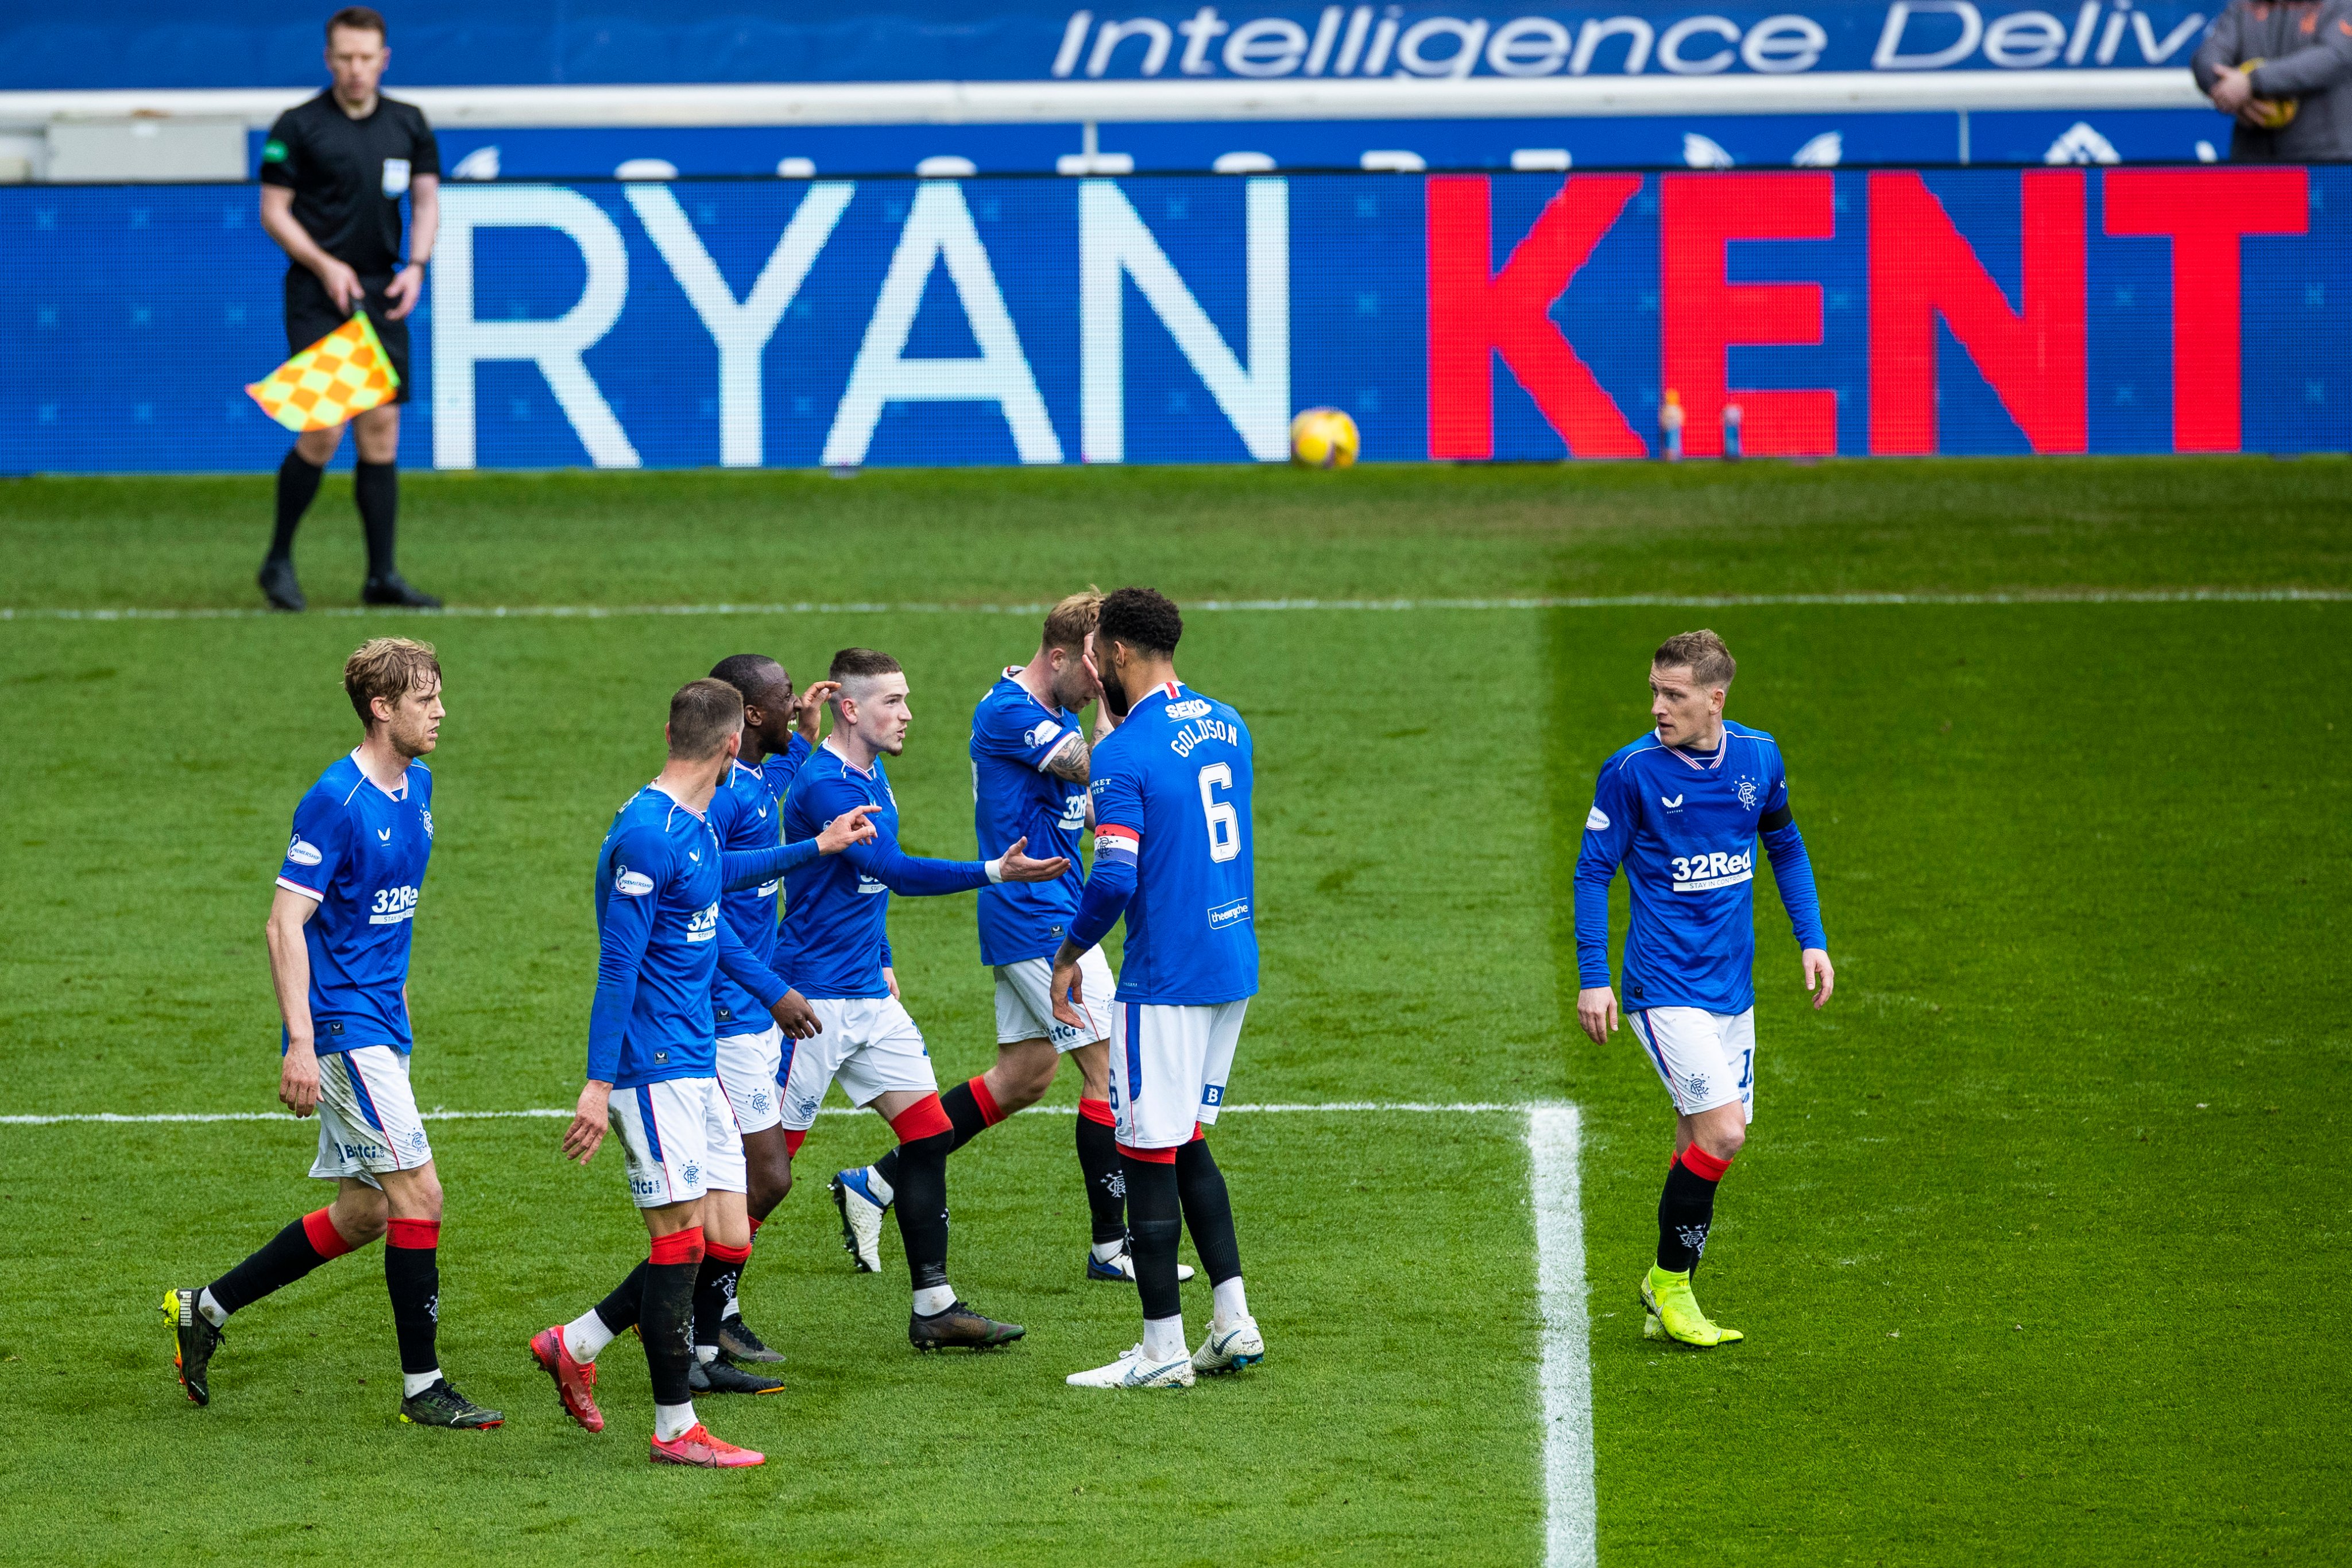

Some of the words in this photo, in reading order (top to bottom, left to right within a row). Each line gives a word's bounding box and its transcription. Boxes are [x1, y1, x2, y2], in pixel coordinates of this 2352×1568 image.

[1051, 5, 1828, 80] Intelligence
[1871, 0, 2207, 68] Deliv
[432, 177, 1290, 470] RYAN
[1426, 167, 2309, 460] KENT
[1165, 699, 1207, 719] SEKO
[1171, 719, 1237, 758] GOLDSON
[1198, 762, 1241, 863] 6
[1672, 846, 1751, 881] 32Red
[1717, 875, 1743, 885] CONTROL
[1047, 1026, 1076, 1042] itci
[180, 1291, 192, 1327] PUMA
